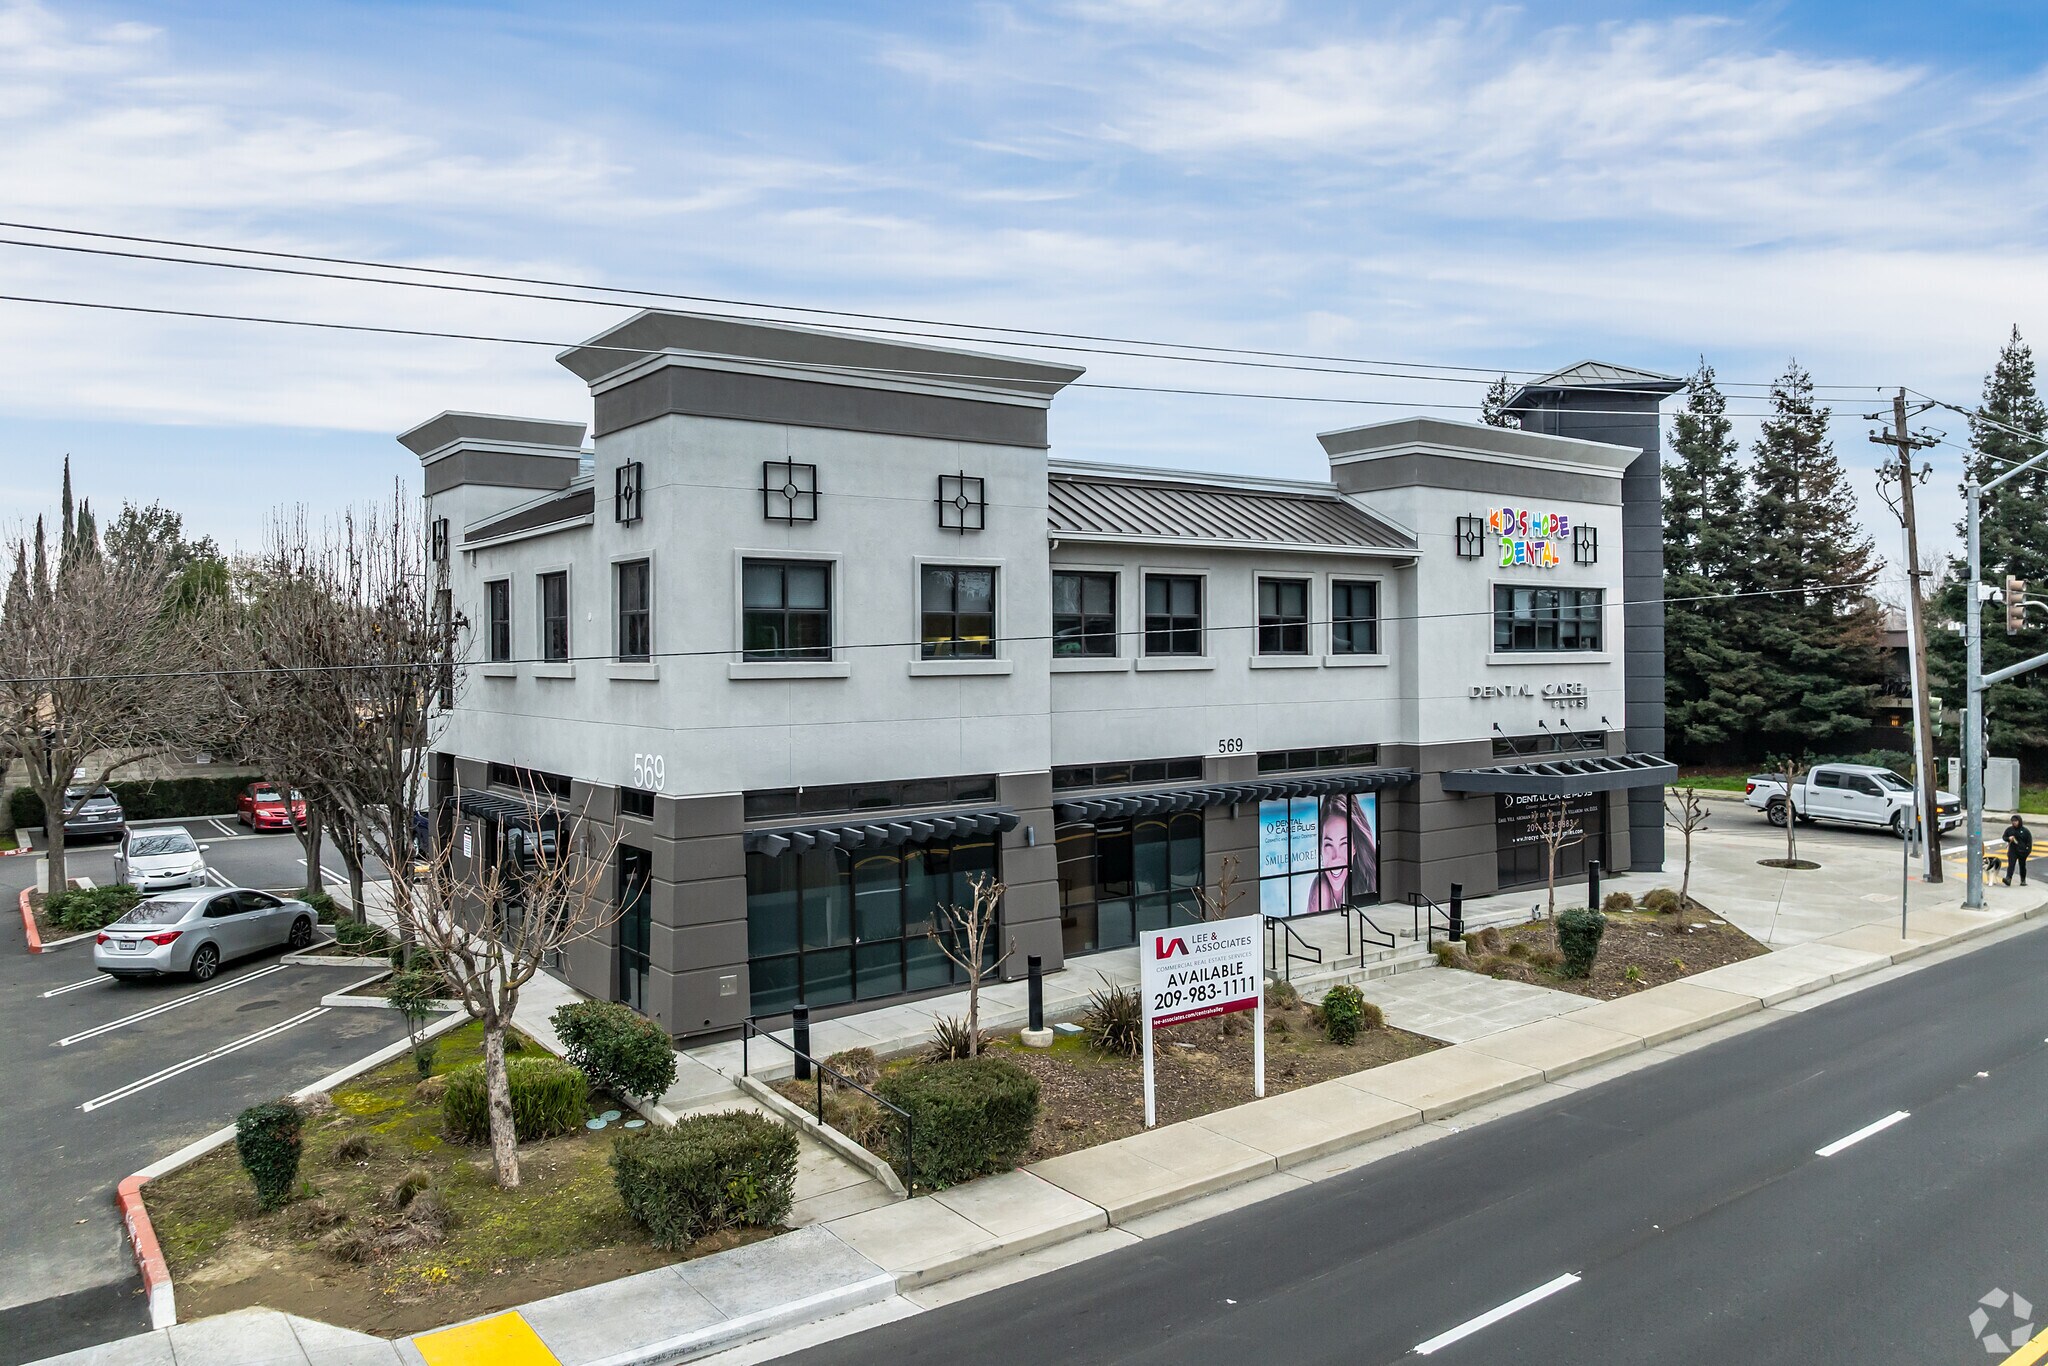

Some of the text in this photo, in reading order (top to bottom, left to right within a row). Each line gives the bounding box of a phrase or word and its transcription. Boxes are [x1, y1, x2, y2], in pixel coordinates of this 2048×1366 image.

[1488, 507, 1570, 538] KID'S HOPE
[1501, 537, 1560, 567] DENTAL
[1469, 683, 1586, 698] DENTAL CARE
[1553, 700, 1586, 709] PLUS
[1219, 737, 1243, 753] 569
[634, 753, 665, 791] 569
[1276, 818, 1303, 827] DENTAL
[1297, 823, 1316, 831] PLUS
[1265, 849, 1317, 866] SMILE MORE!
[1192, 933, 1208, 944] LEE
[1210, 932, 1218, 941] &
[1195, 936, 1252, 954] ASSOCIATES
[1156, 962, 1193, 973] COMMERCIAL
[1208, 956, 1226, 964] ESTATE
[1228, 951, 1253, 960] SERVICES
[1167, 961, 1244, 988] AVAILABLE
[1154, 976, 1255, 1011] 209-983-1111
[1153, 1007, 1224, 1025] lee-associates.com/centralvalley
